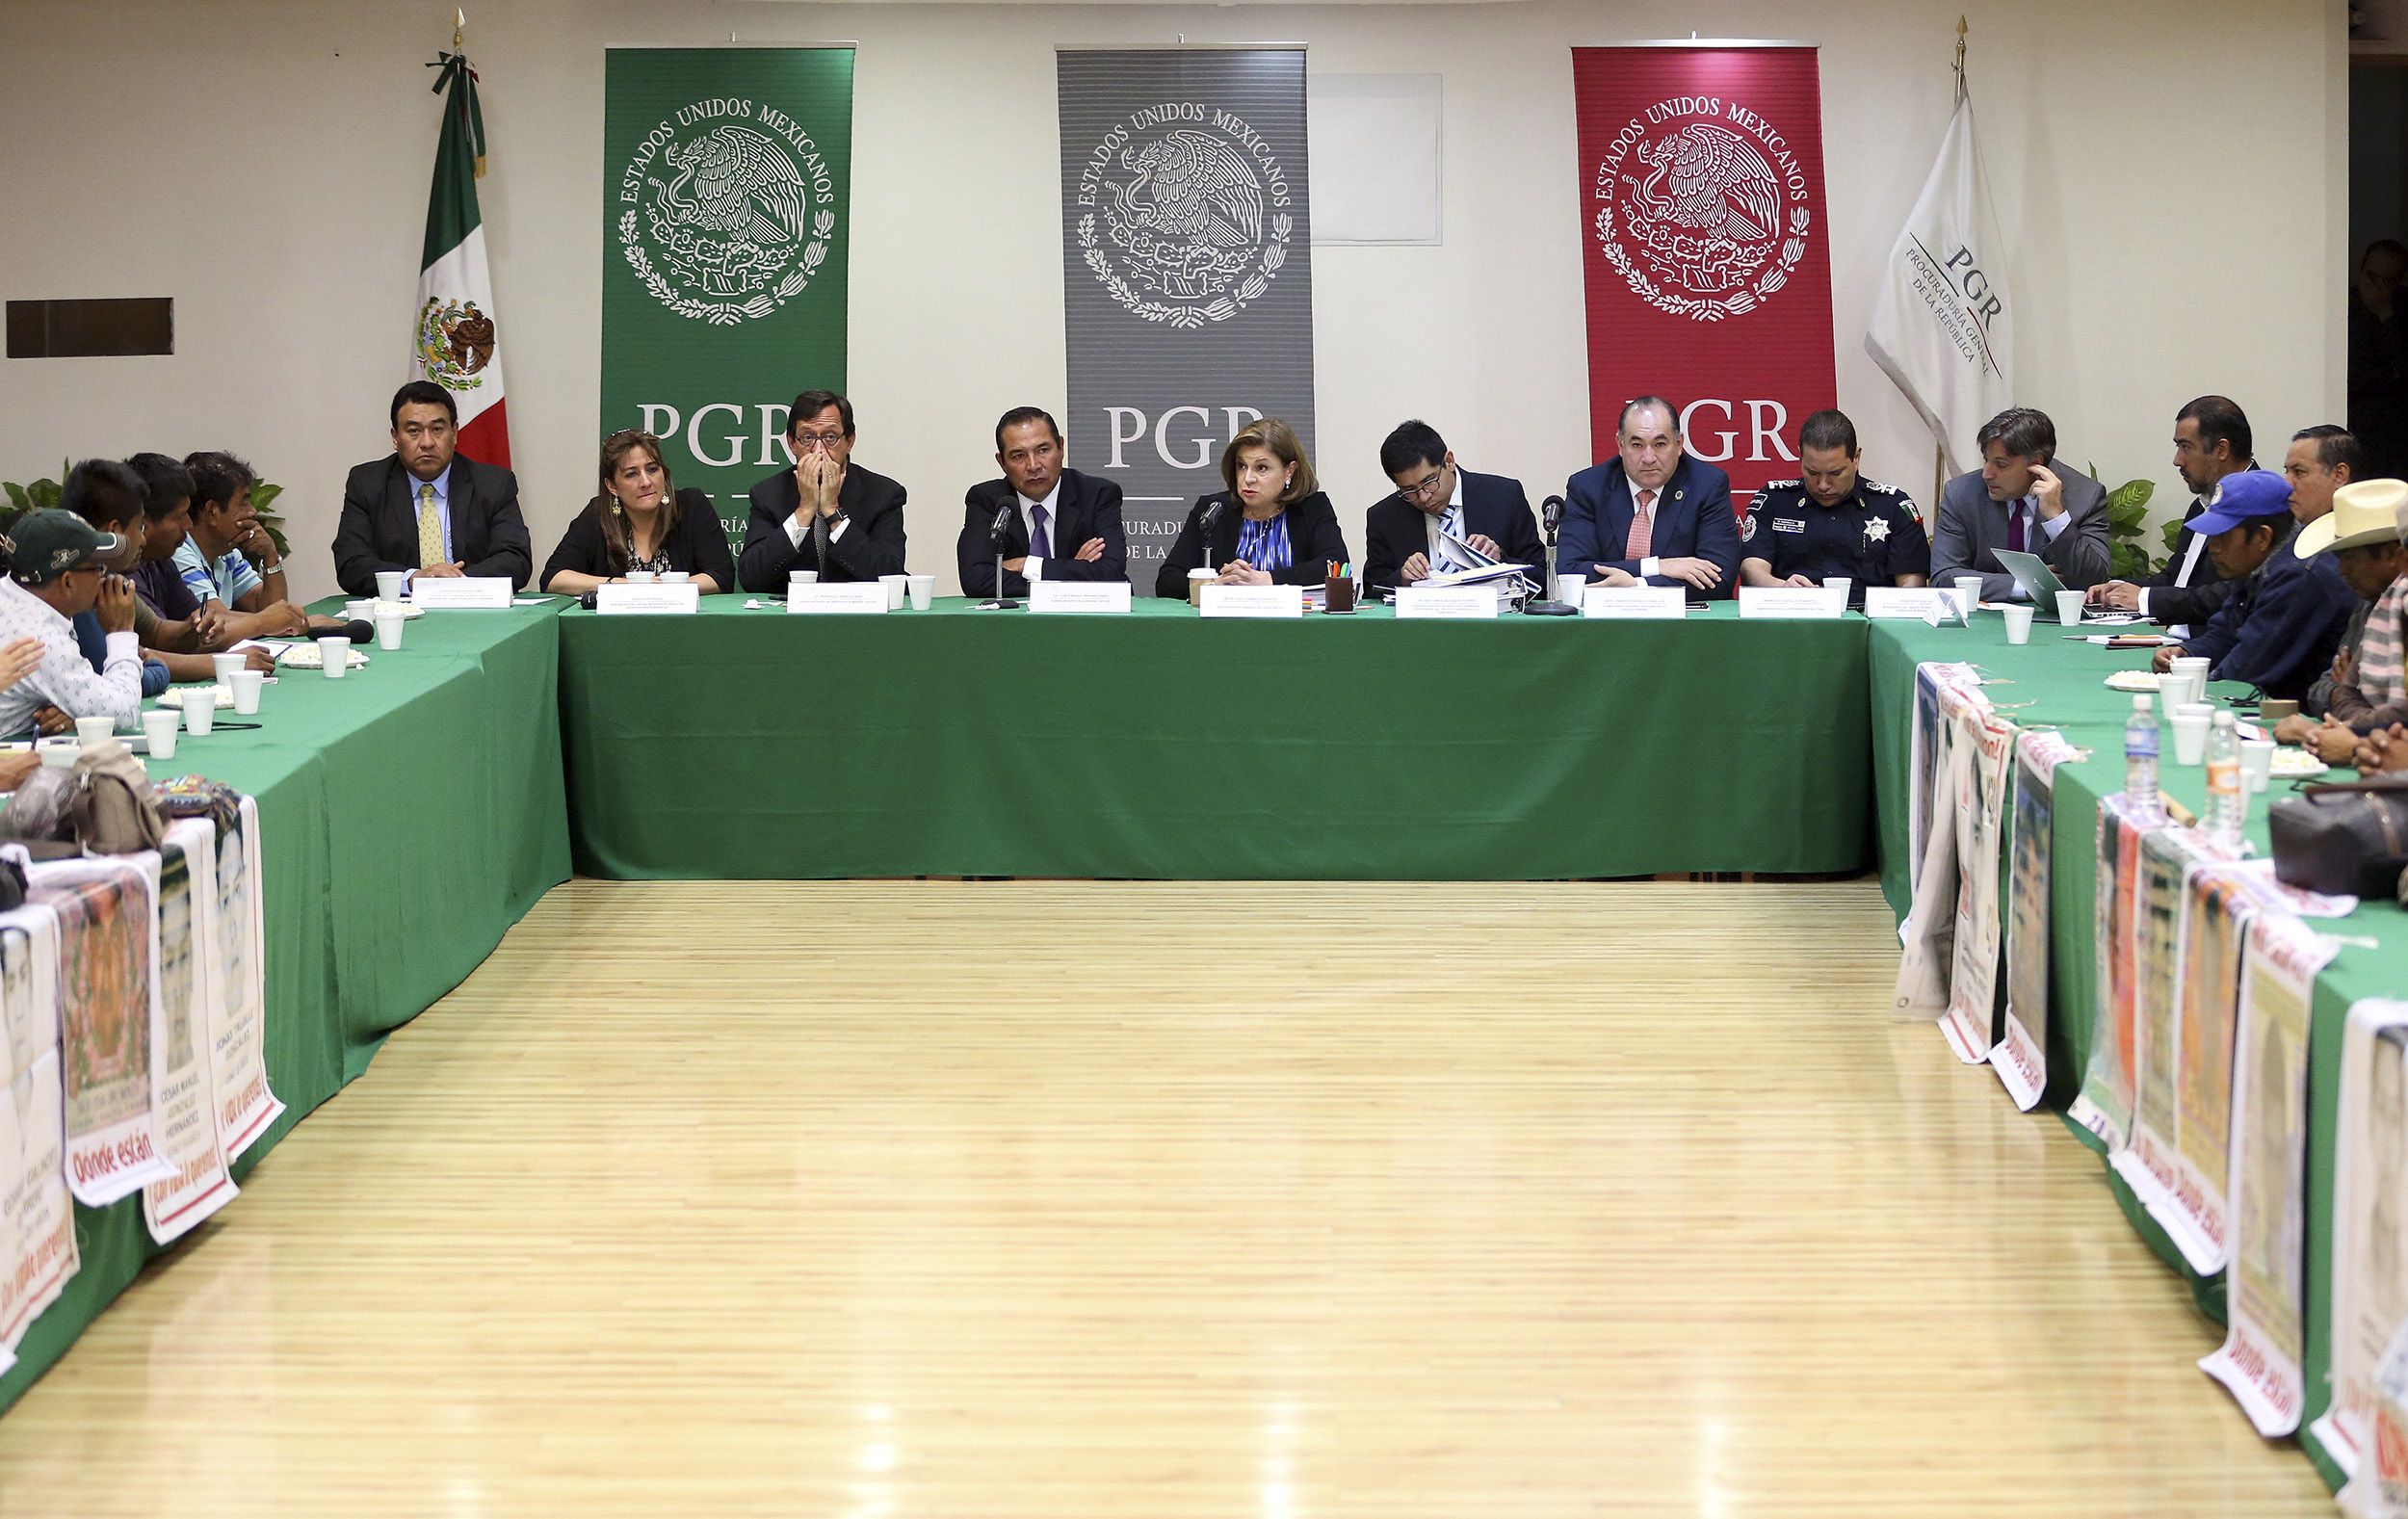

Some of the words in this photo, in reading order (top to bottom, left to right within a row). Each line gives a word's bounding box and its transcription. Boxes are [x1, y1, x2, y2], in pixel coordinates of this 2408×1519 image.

[620, 120, 674, 203] ESTADOS
[676, 97, 752, 126] UNIDOS
[757, 104, 833, 204] MEXICANOS
[1078, 124, 1129, 207] ESTADOS
[1130, 102, 1205, 130] UNIDOS
[1211, 108, 1291, 207] MEXICANOS
[1595, 118, 1645, 200] ESTADOS
[1645, 95, 1720, 124] UNIDOS
[1726, 102, 1808, 201] MEXICANOS
[1906, 249, 1967, 328] PROCURADURÍA
[1912, 278, 1926, 295] DE
[1924, 293, 1936, 308] LA
[1934, 307, 1976, 362] REPÚBLICA
[1945, 245, 2002, 332] PGR
[1625, 399, 1801, 462] GR
[1145, 545, 1167, 559] LA
